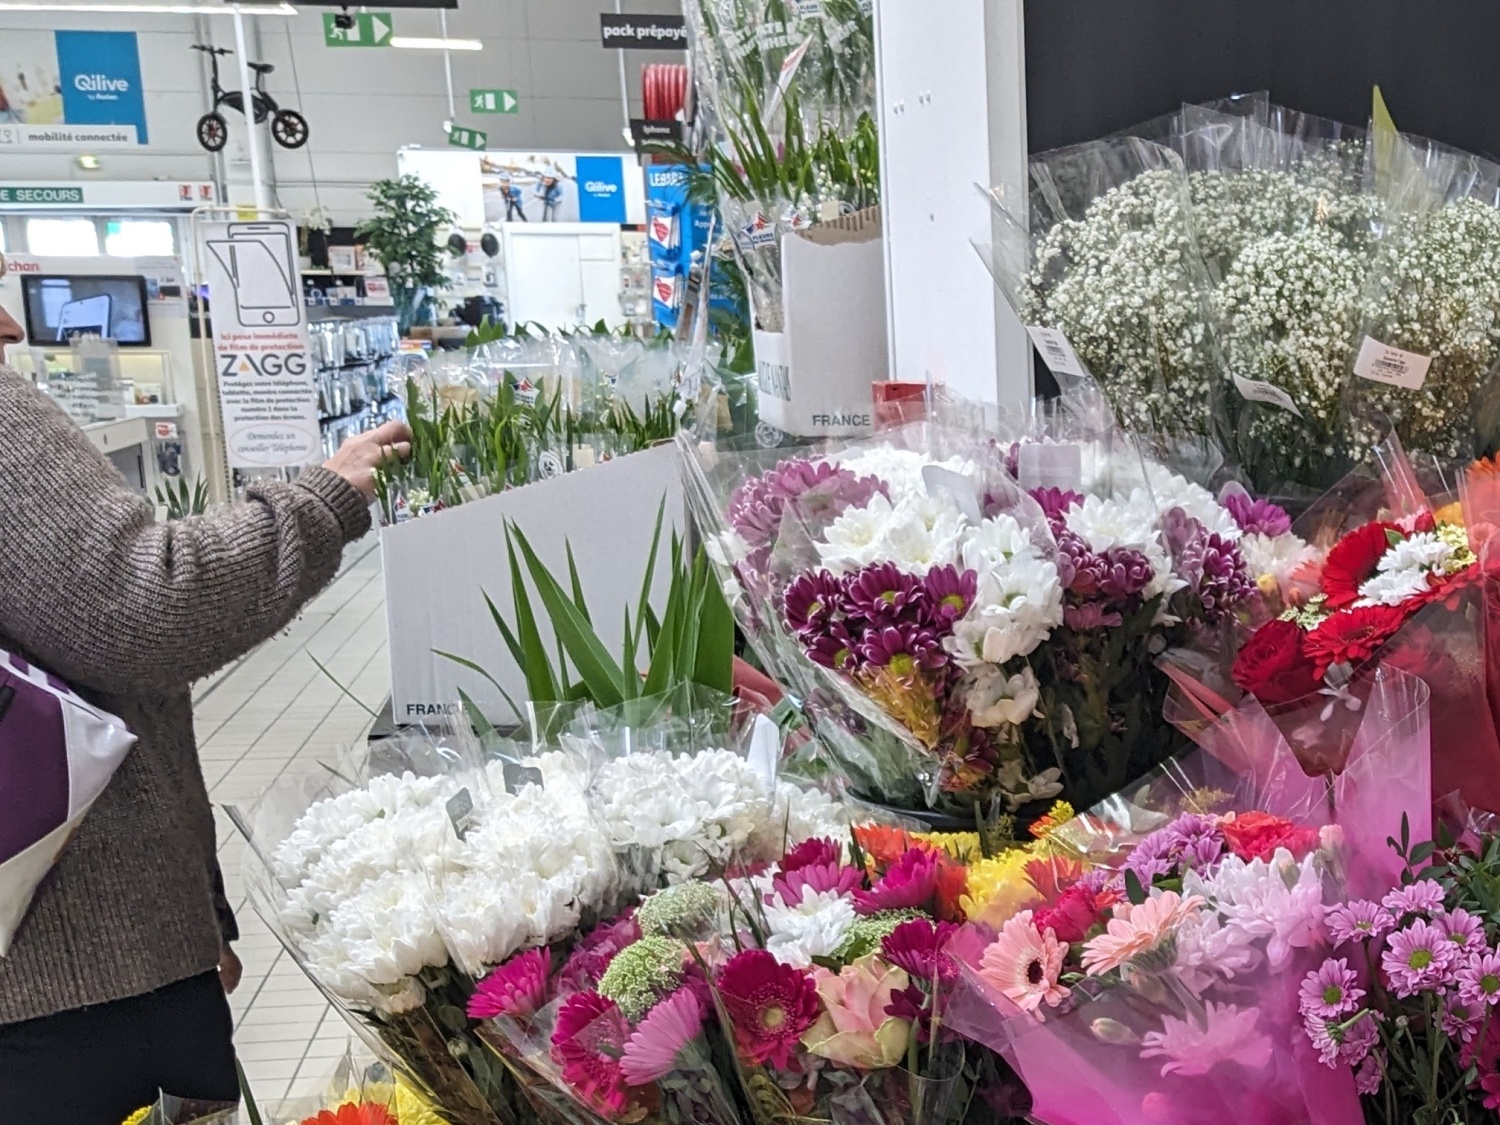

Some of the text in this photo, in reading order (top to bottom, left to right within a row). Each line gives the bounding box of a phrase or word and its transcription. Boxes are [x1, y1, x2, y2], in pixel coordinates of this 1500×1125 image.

[603, 24, 687, 39] pack prépayé
[74, 74, 129, 91] Qilive
[28, 132, 128, 142] mobilité connectée
[0, 189, 79, 201] E SECOURS
[8, 260, 40, 271] chan
[220, 353, 307, 376] ZAGG
[812, 414, 871, 426] FRANCE
[406, 703, 457, 716] FRANC
